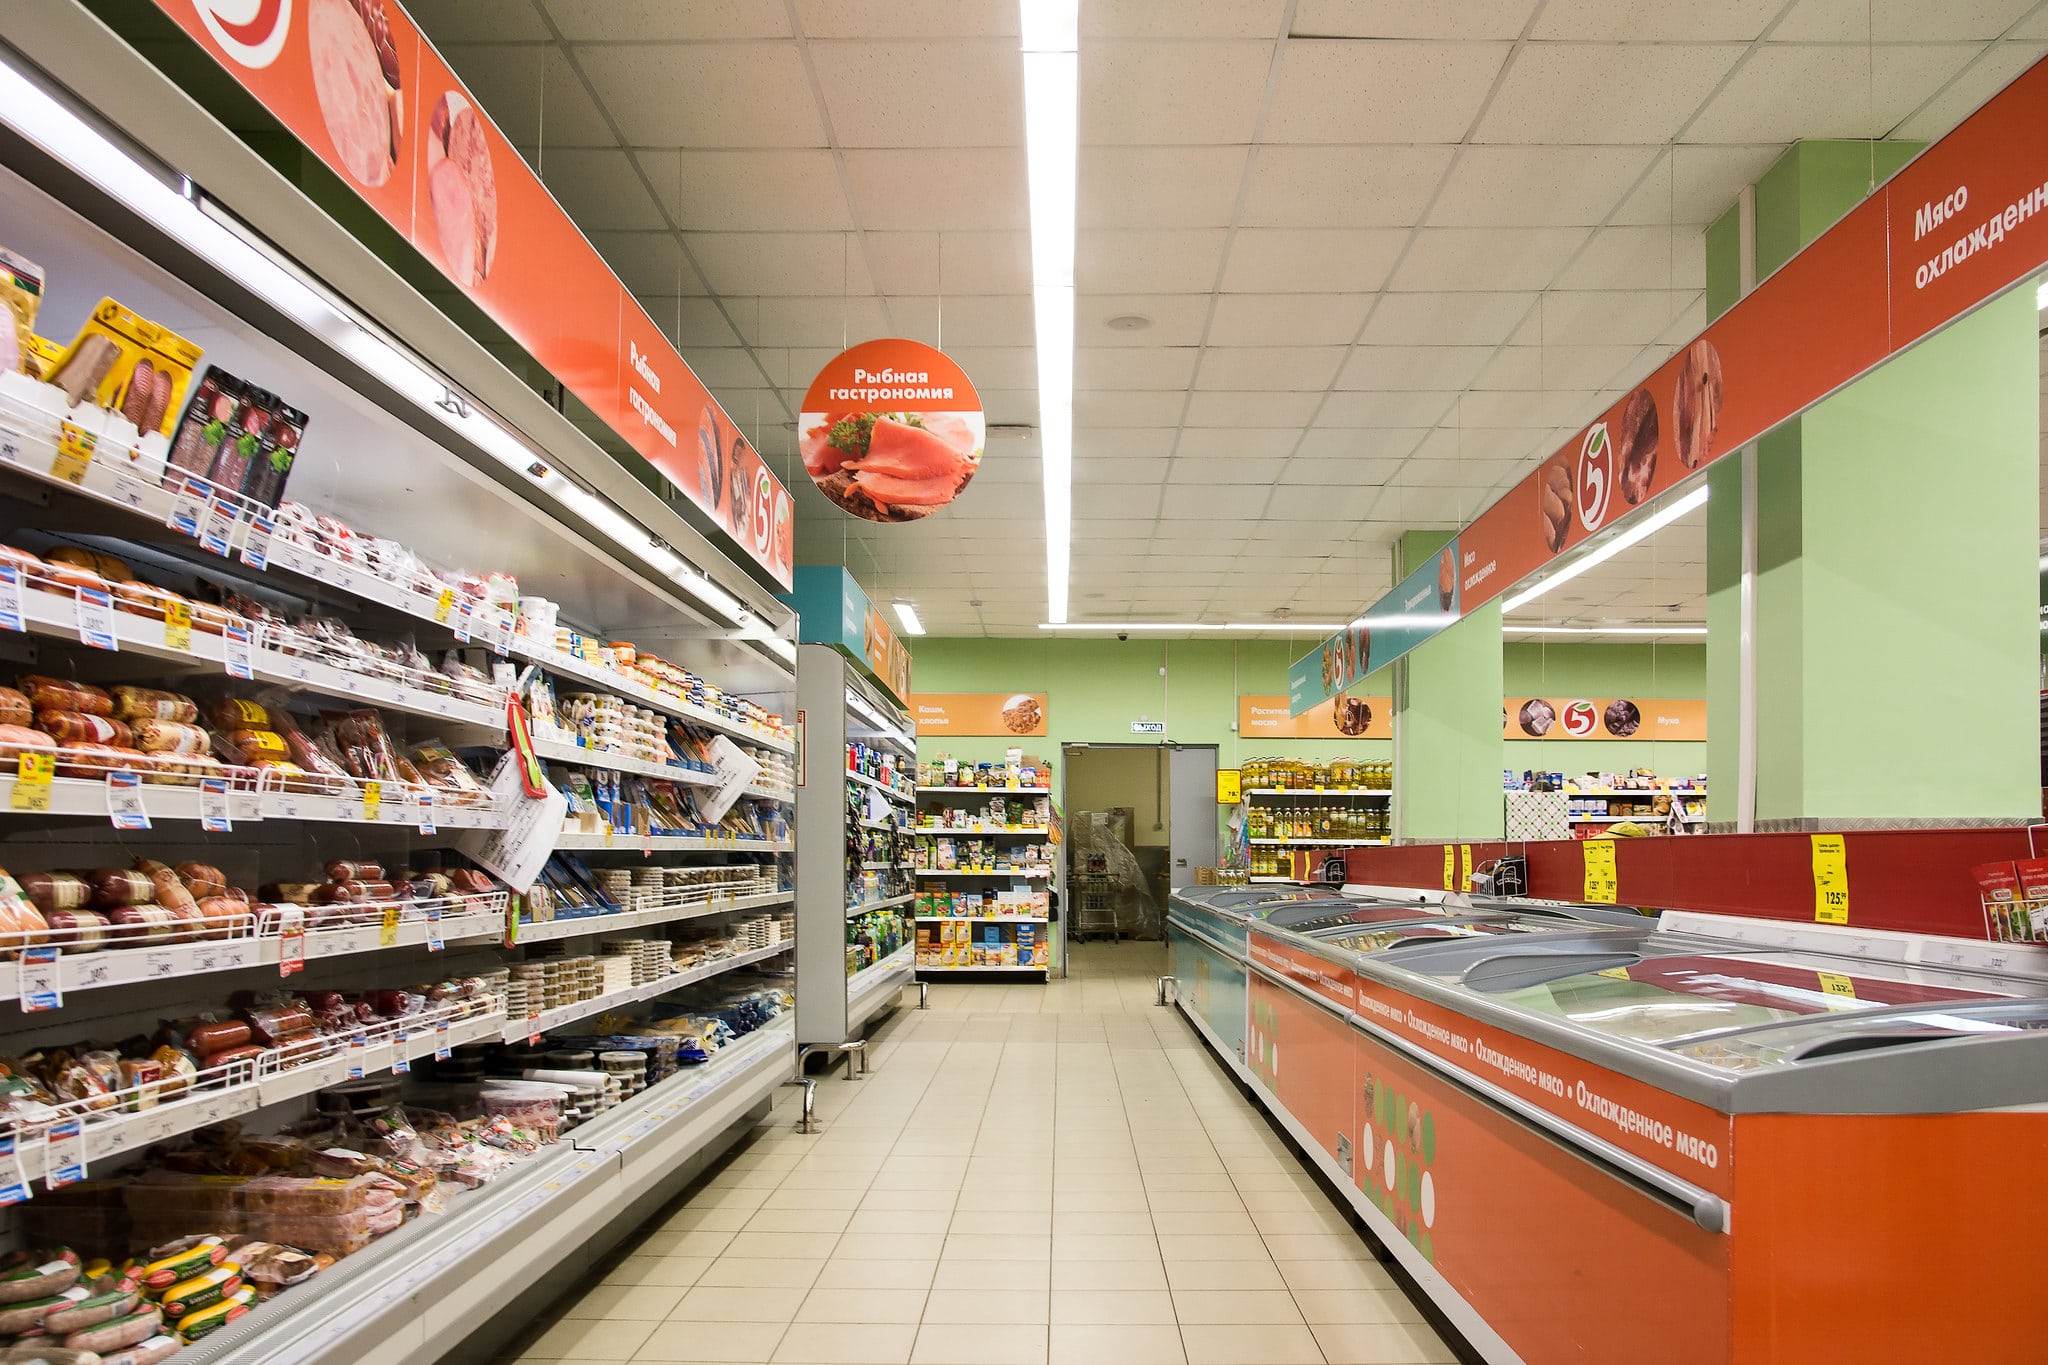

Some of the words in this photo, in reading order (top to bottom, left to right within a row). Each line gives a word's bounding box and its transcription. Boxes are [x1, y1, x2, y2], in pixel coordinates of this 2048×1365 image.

[1914, 185, 1968, 242] Мясо
[1915, 181, 2048, 290] охлажденн
[630, 339, 661, 395] Рыбная
[829, 387, 954, 404] гастрономия
[854, 367, 929, 384] Рыбная
[629, 386, 677, 449] гастрономия
[1407, 1009, 1451, 1046] Охлажденное
[1450, 1032, 1468, 1054] мясо
[1475, 1037, 1537, 1086] Охлажденное
[1538, 1070, 1564, 1098] мясо
[1576, 1079, 1673, 1148] Охлажденное
[1676, 1130, 1718, 1169] мясо
